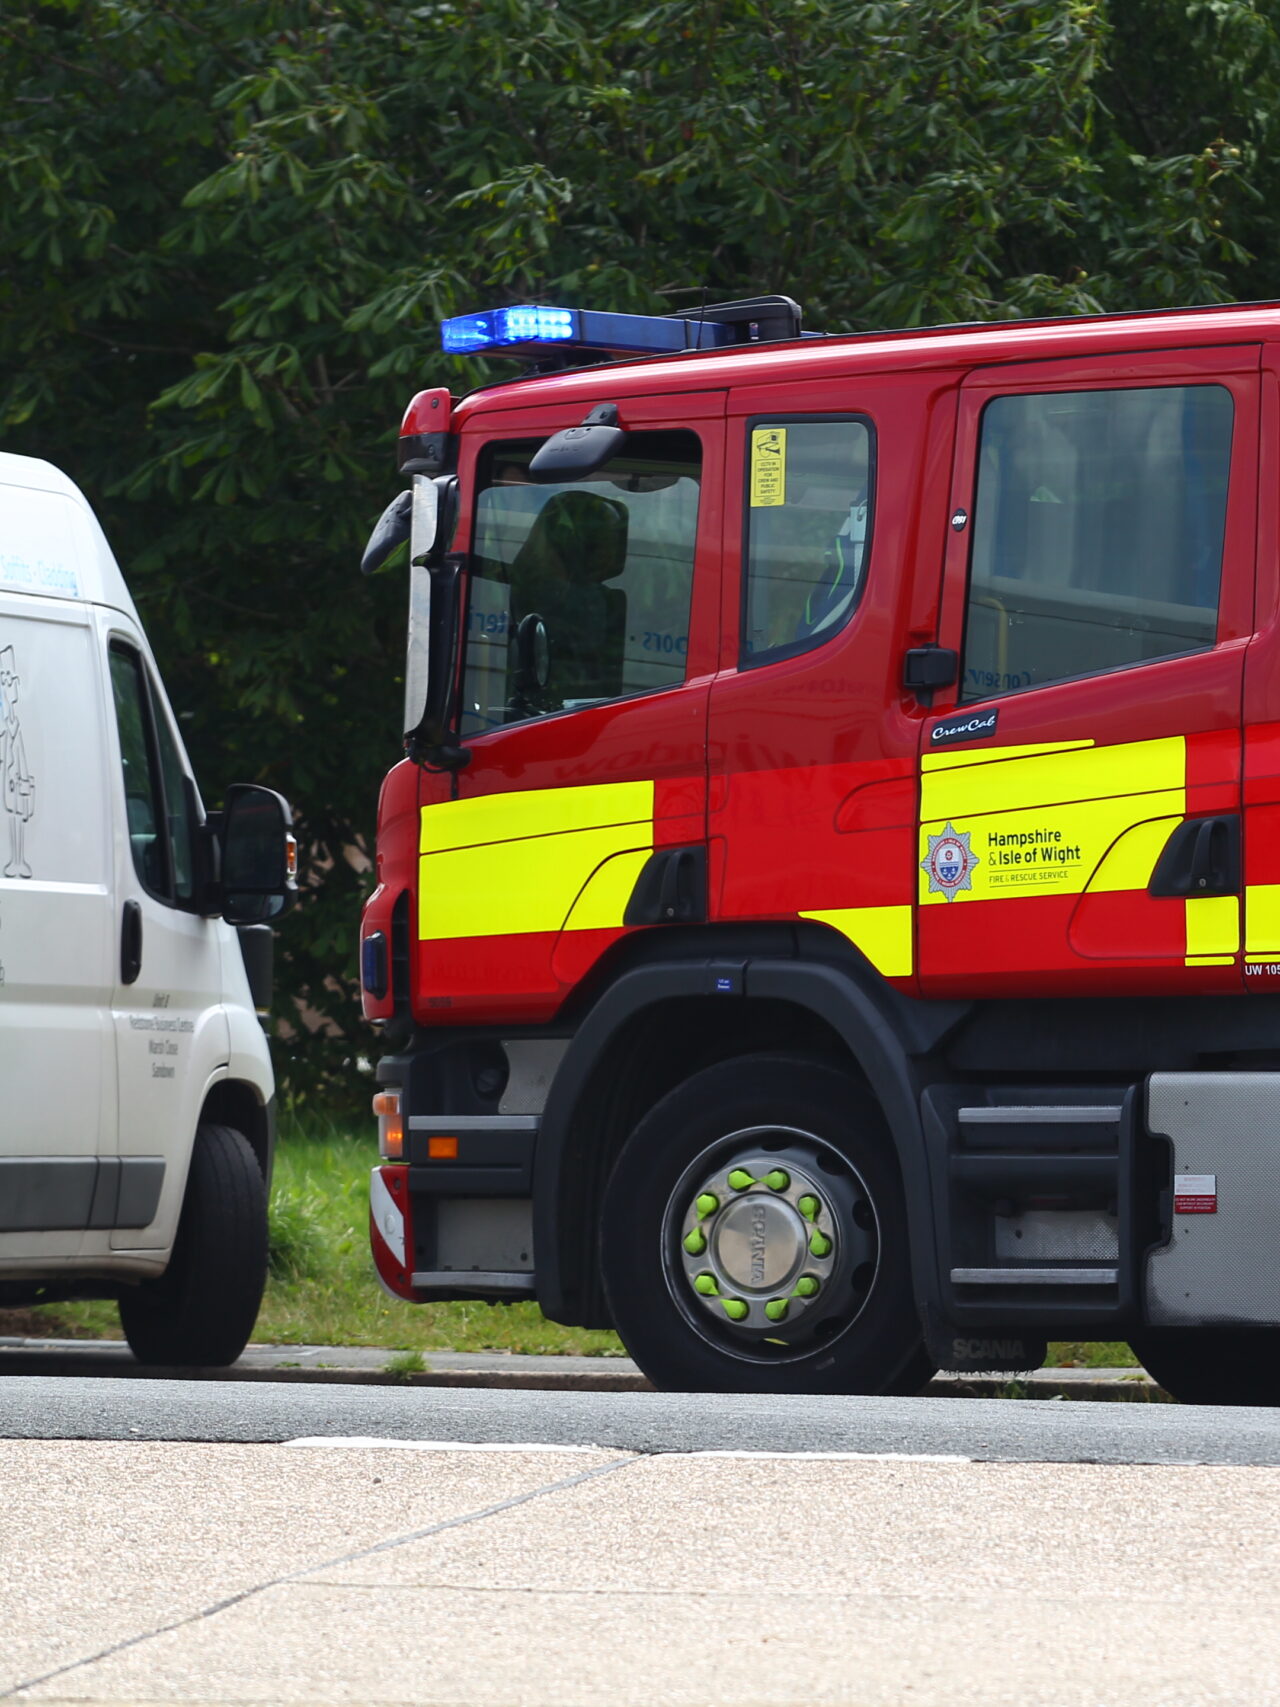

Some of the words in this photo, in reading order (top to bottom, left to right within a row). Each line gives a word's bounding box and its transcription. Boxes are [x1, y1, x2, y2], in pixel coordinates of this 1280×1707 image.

[931, 715, 996, 740] CrewCab
[988, 828, 1062, 847] Hampshire
[988, 852, 997, 866] &
[999, 850, 1022, 865] Isle
[1024, 847, 1039, 862] of
[1041, 845, 1081, 864] Wight
[989, 875, 1004, 883] FIRE
[1011, 873, 1038, 882] RESCUE
[1039, 870, 1069, 880] SERVICE
[1245, 965, 1262, 975] UW
[751, 1204, 766, 1285] SCANIA
[952, 1339, 1025, 1359] SCANIA
